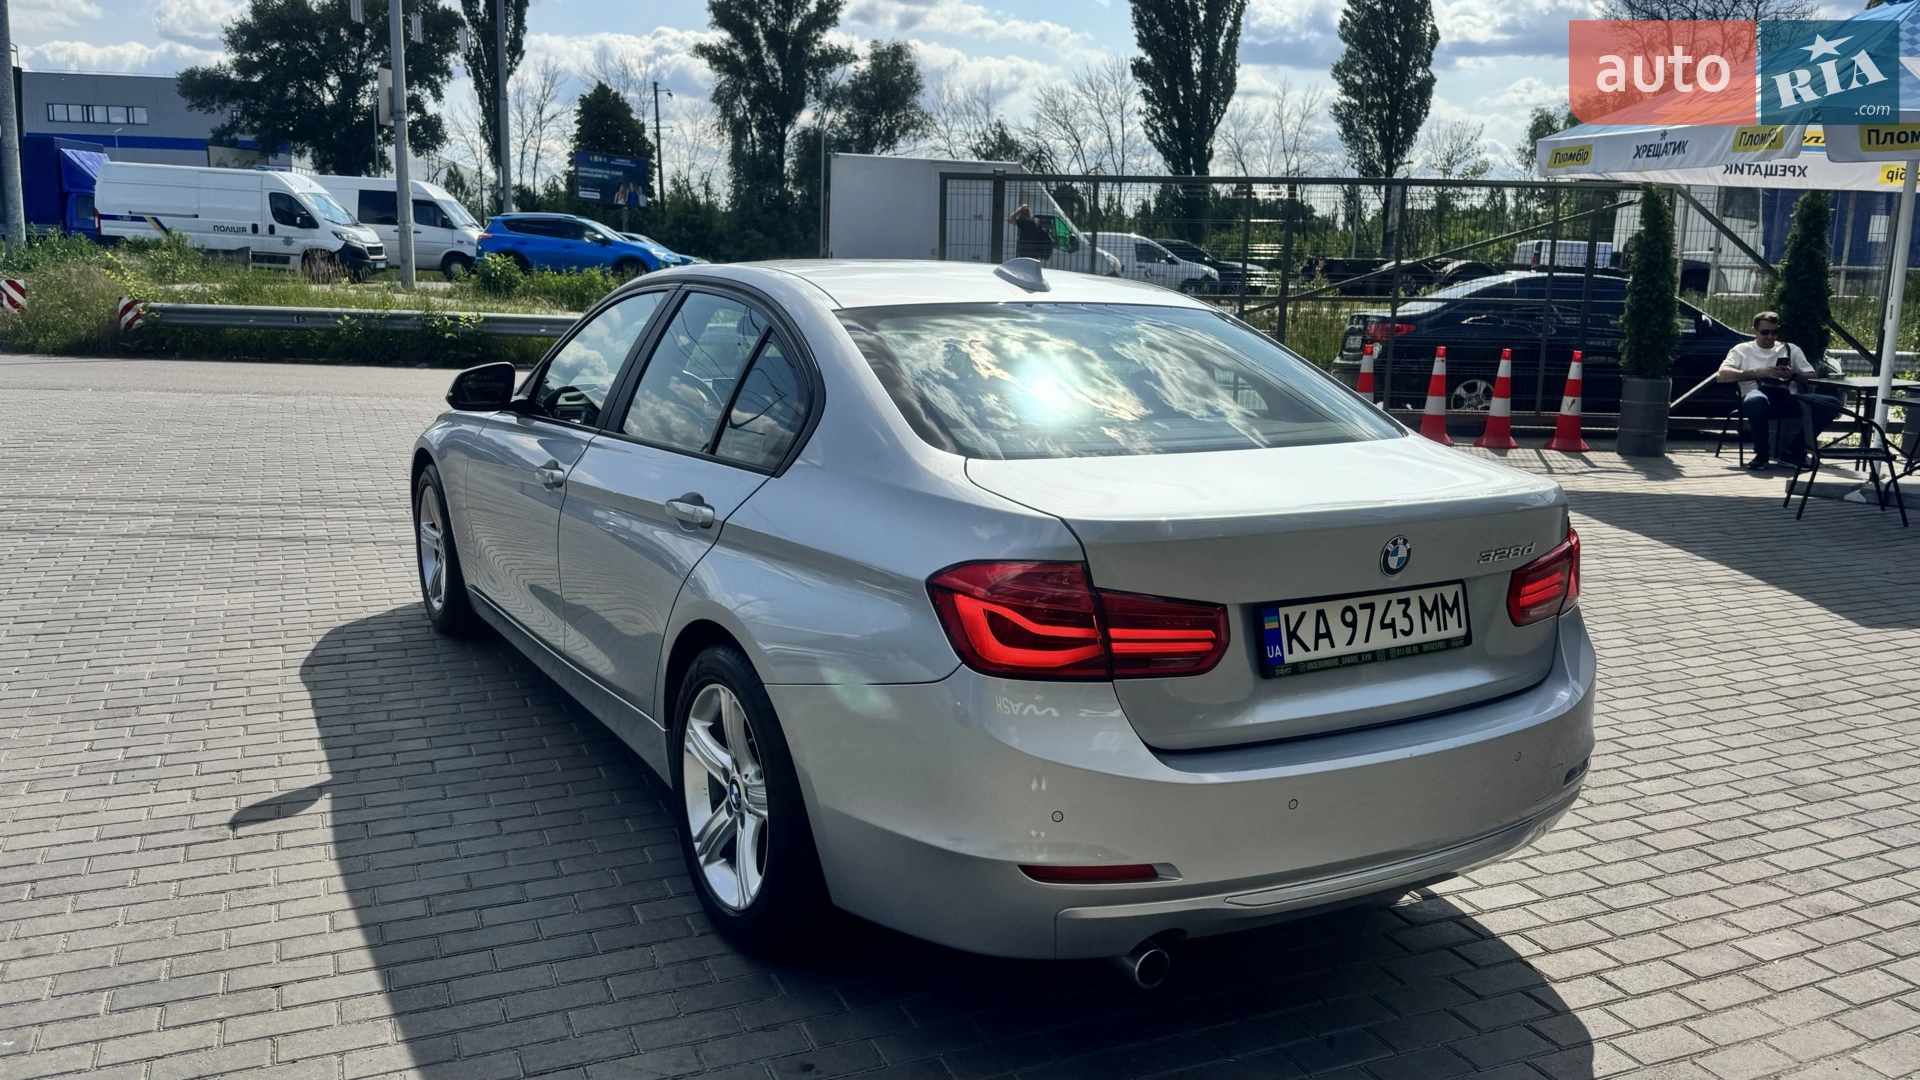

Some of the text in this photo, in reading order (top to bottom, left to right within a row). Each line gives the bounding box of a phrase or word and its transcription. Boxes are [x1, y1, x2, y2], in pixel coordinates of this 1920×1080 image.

[1632, 139, 1690, 160] ХРЕЩАТИК
[213, 224, 248, 234] ПОЛІЦІЯ
[1478, 541, 1537, 565] 328d
[1266, 645, 1283, 659] UA
